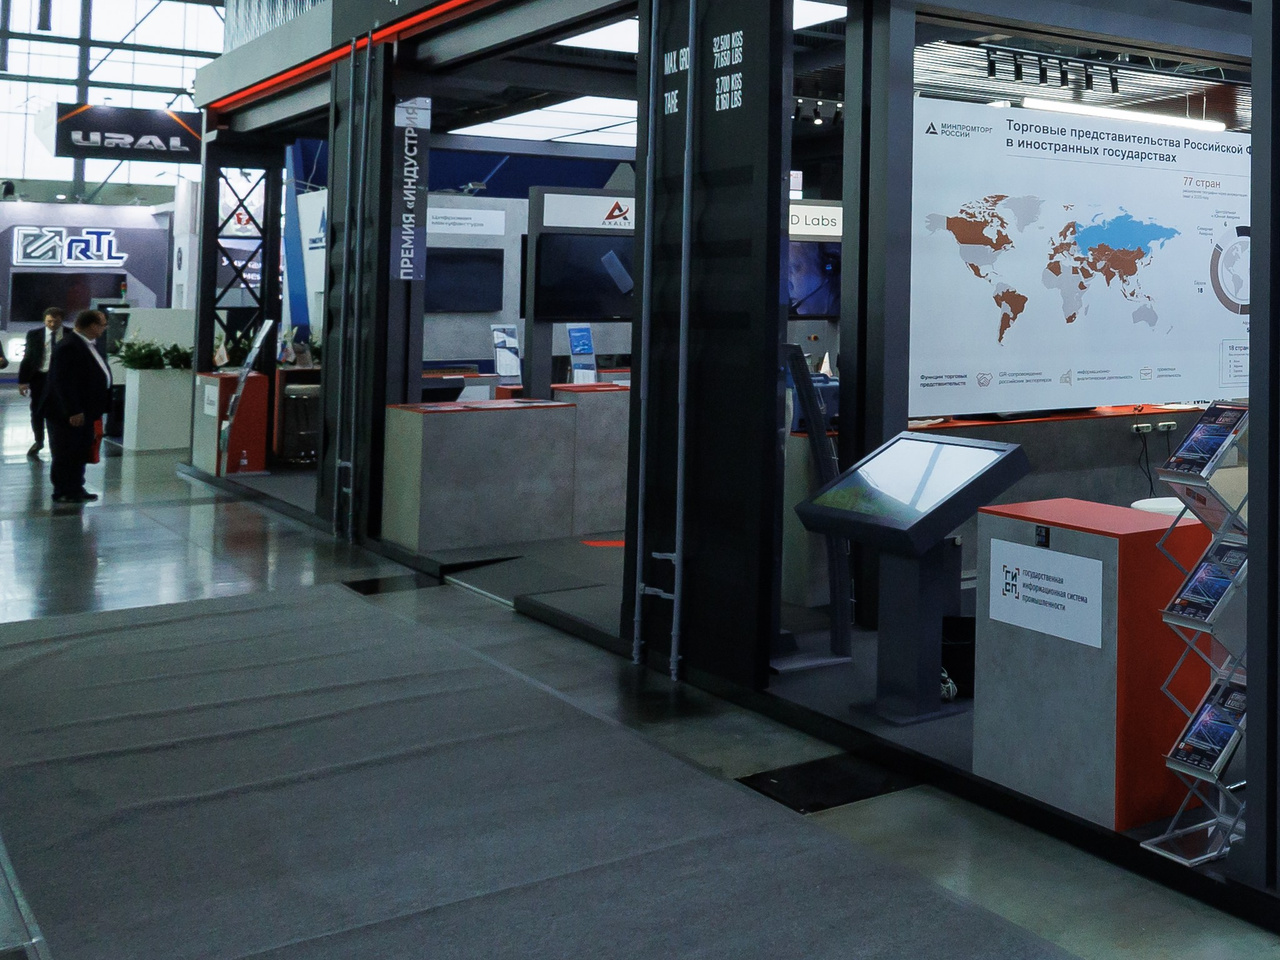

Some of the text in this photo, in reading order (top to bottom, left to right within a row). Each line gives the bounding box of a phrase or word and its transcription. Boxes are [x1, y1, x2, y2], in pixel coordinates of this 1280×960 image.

[731, 47, 743, 65] LBS
[664, 89, 679, 115] TARE
[731, 90, 742, 108] LBS
[941, 123, 993, 134] МИНПРОМТОРГ
[941, 130, 971, 138] РОССИИ
[1006, 118, 1067, 136] Торговые
[1070, 128, 1181, 148] представительства
[1183, 138, 1243, 155] Российской
[71, 130, 190, 151] URAL
[1006, 138, 1177, 162] в иностранных государствах
[1183, 176, 1221, 189] 77 стран
[804, 214, 837, 227] Labs
[64, 229, 128, 265] RTL
[400, 215, 416, 279] ПРЕМИЯ
[1022, 569, 1064, 585] государственная
[1022, 581, 1088, 603] информационная система
[1022, 594, 1066, 611] промышленности
